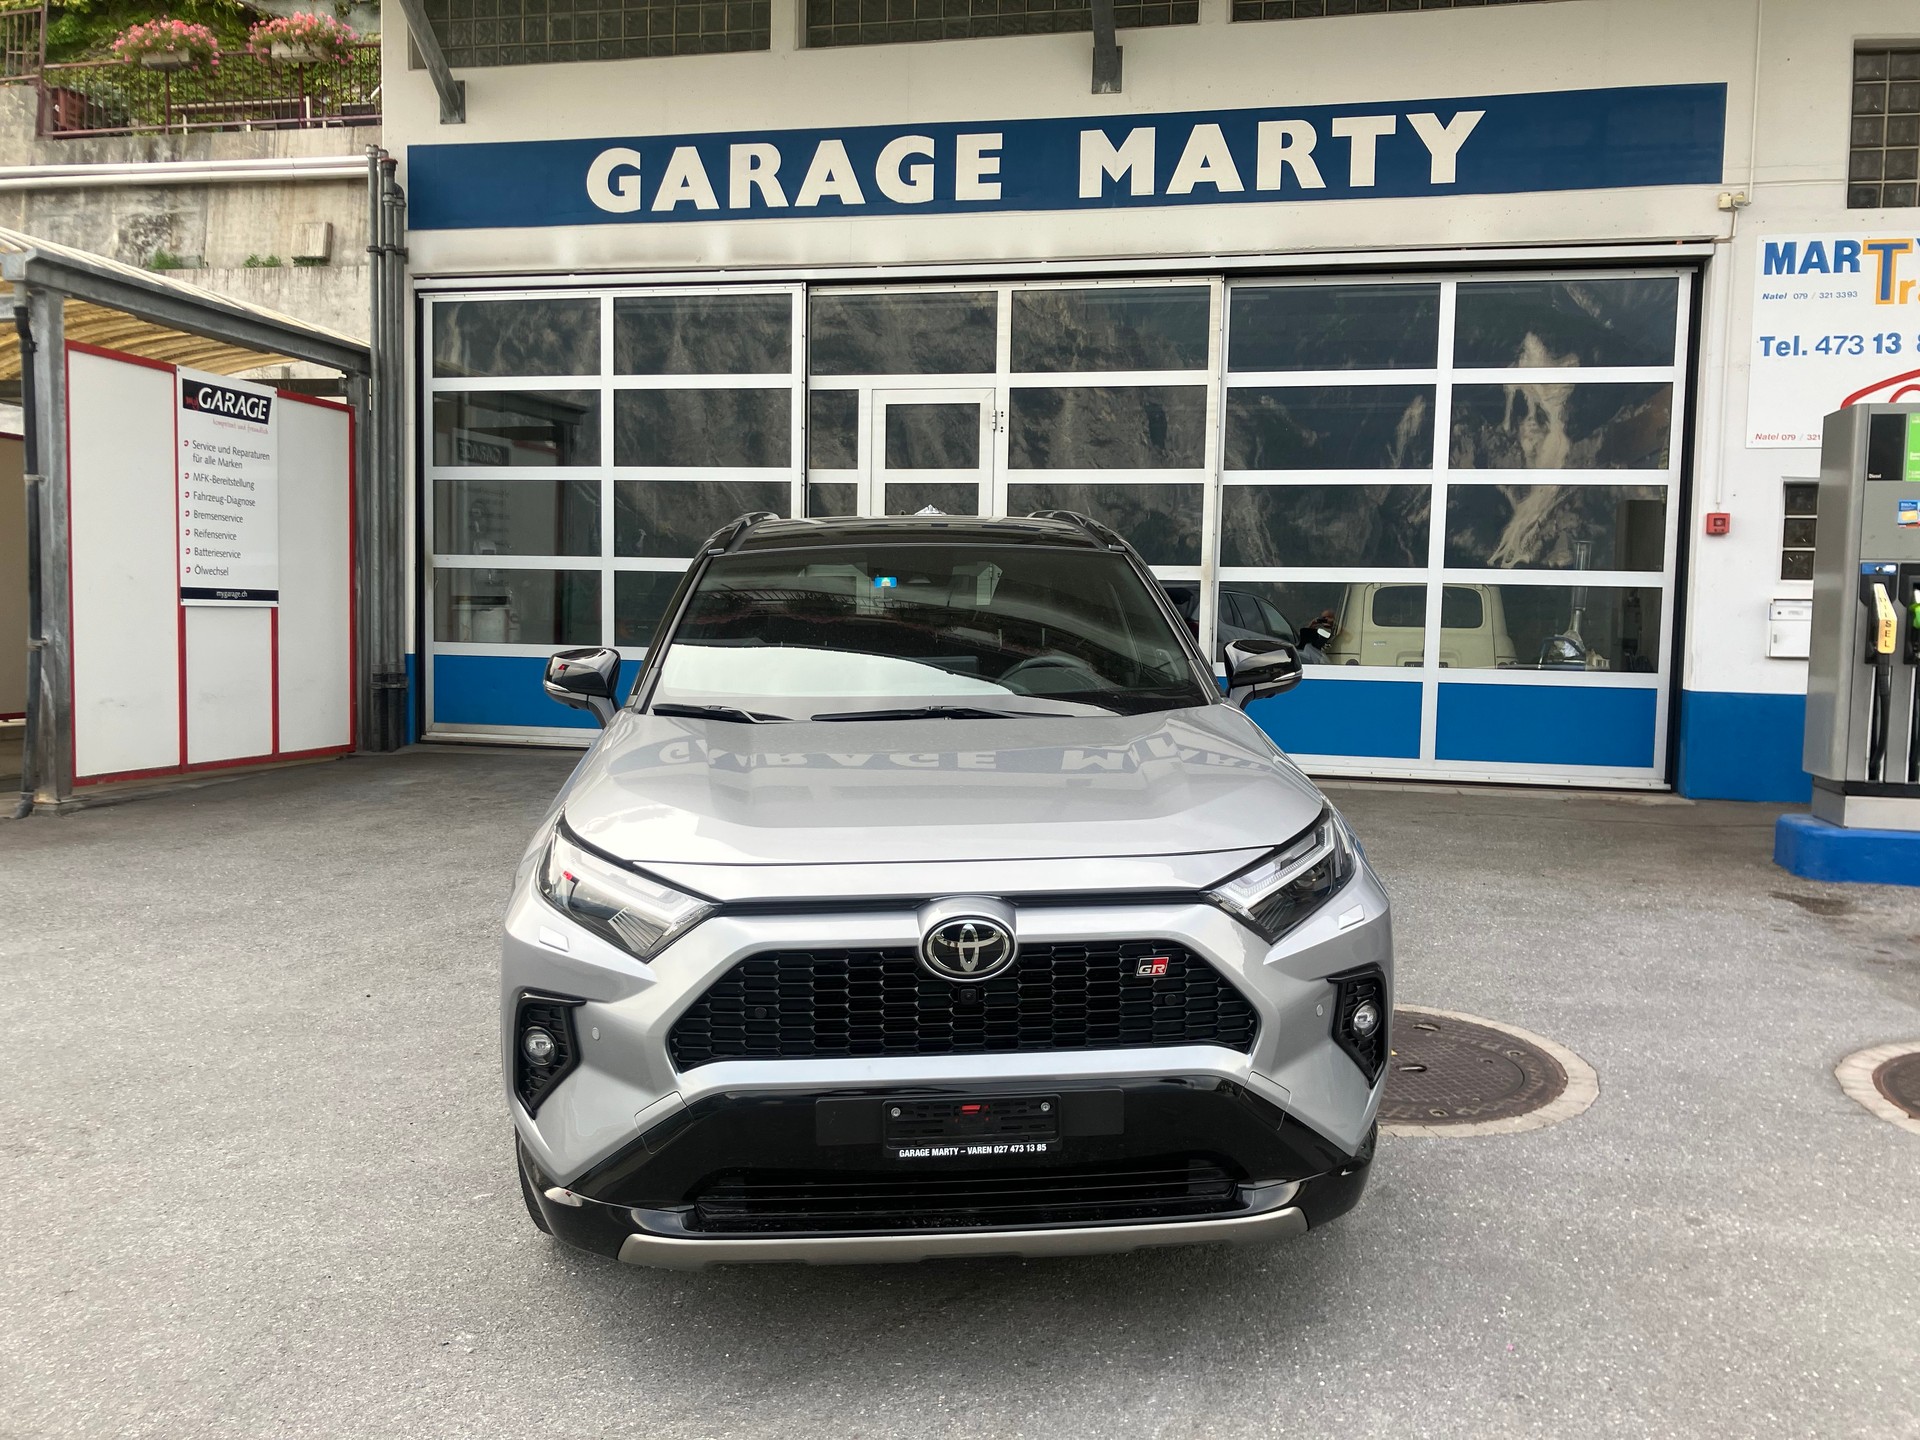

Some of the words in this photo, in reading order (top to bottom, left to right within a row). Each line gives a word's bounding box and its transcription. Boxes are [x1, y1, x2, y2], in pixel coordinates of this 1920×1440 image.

[586, 132, 1003, 213] GARAGE
[1079, 110, 1487, 198] MARTY
[1763, 238, 1920, 304] MART
[1762, 292, 1787, 300] Natel
[1760, 335, 1807, 357] Tel.
[1815, 335, 1865, 355] 473
[1872, 332, 1902, 354] 13
[1755, 433, 1779, 441] Natel
[1781, 433, 1796, 441] 079
[192, 440, 216, 452] Service
[218, 445, 231, 455] und
[232, 447, 270, 461] Reparaturen
[192, 453, 202, 463] für
[204, 456, 216, 466] alle
[218, 458, 243, 469] Marken
[193, 472, 255, 491] MFK-Bereitstellung
[193, 491, 256, 507] Fahrzeug-Diagnose
[193, 510, 244, 523] Bremsenservice
[193, 528, 237, 541] Reifenservice
[194, 547, 241, 559] Batterieservice
[194, 563, 229, 576] Ölwechsel
[216, 590, 248, 600] mygarage.ch
[1138, 964, 1166, 974] GR
[899, 1149, 930, 1158] GARAGE
[932, 1147, 959, 1157] MARTY
[967, 1146, 993, 1155] VAREN
[994, 1145, 1008, 1153] 027
[1010, 1145, 1024, 1153] 473
[1026, 1144, 1035, 1152] 13
